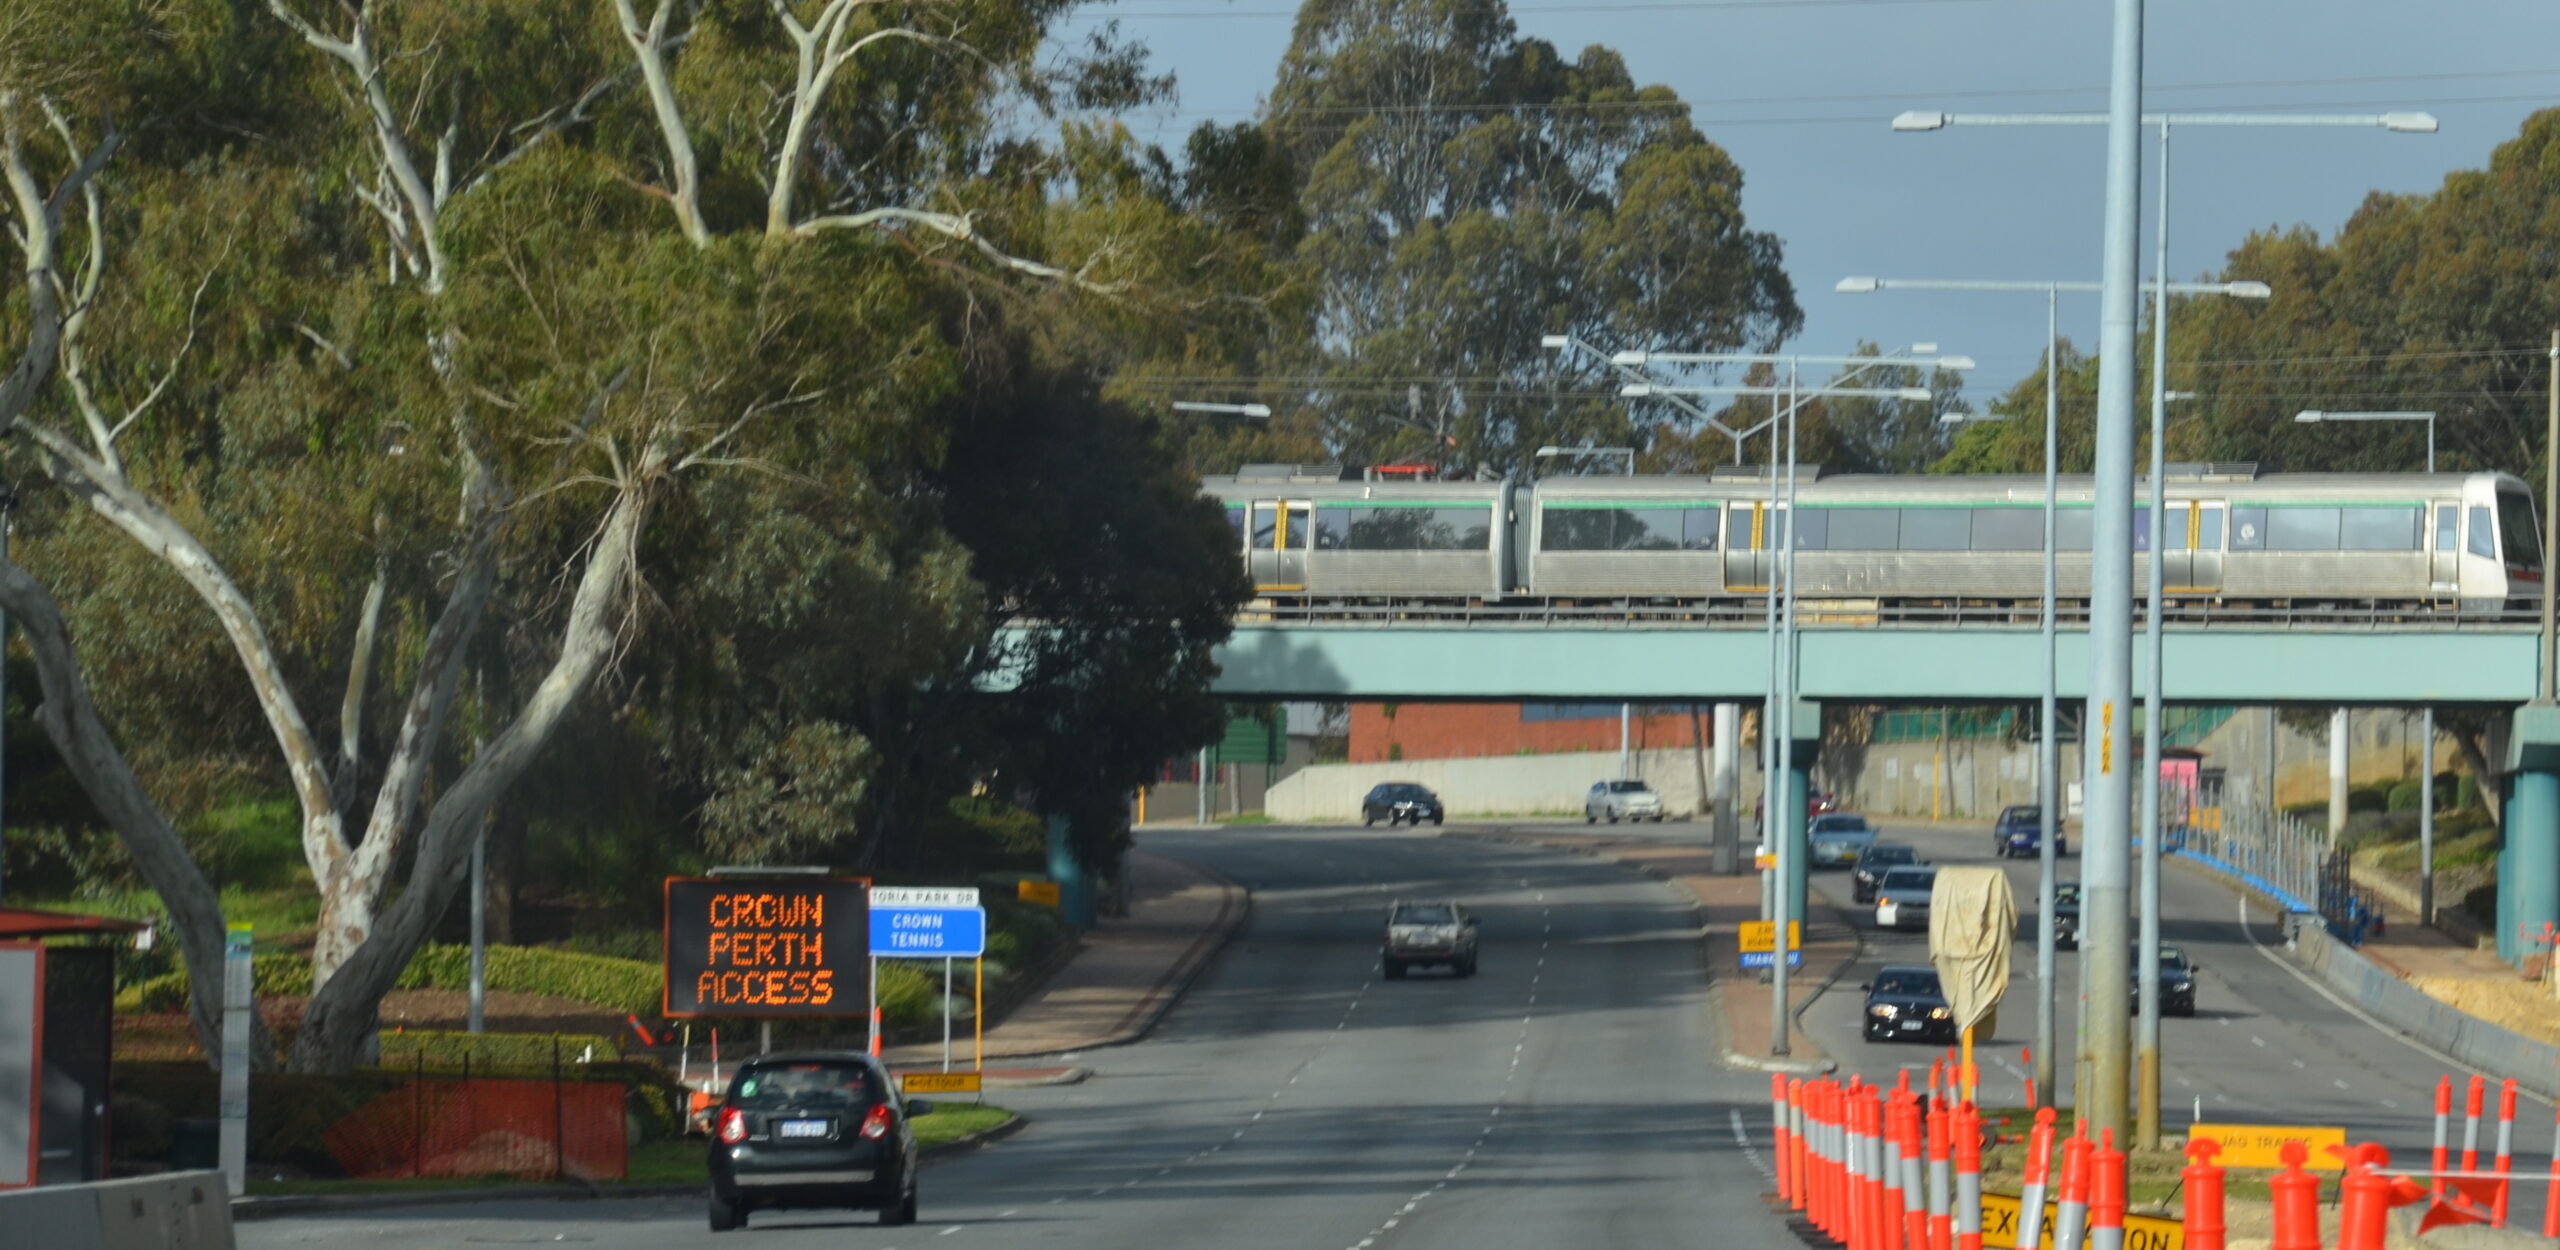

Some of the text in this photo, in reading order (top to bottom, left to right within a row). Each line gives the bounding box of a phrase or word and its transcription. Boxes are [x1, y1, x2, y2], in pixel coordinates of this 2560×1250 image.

[916, 891, 950, 902] PARK
[957, 892, 974, 903] DR
[710, 894, 823, 928] CROWN
[891, 912, 943, 929] CROWN
[889, 931, 945, 948] TENNIS
[708, 931, 823, 967] PERTH
[697, 970, 834, 1005] ACCESS
[919, 1077, 965, 1089] DETOUR
[2255, 1135, 2312, 1149] TRAC
[1981, 1206, 2170, 1250] EXAON
